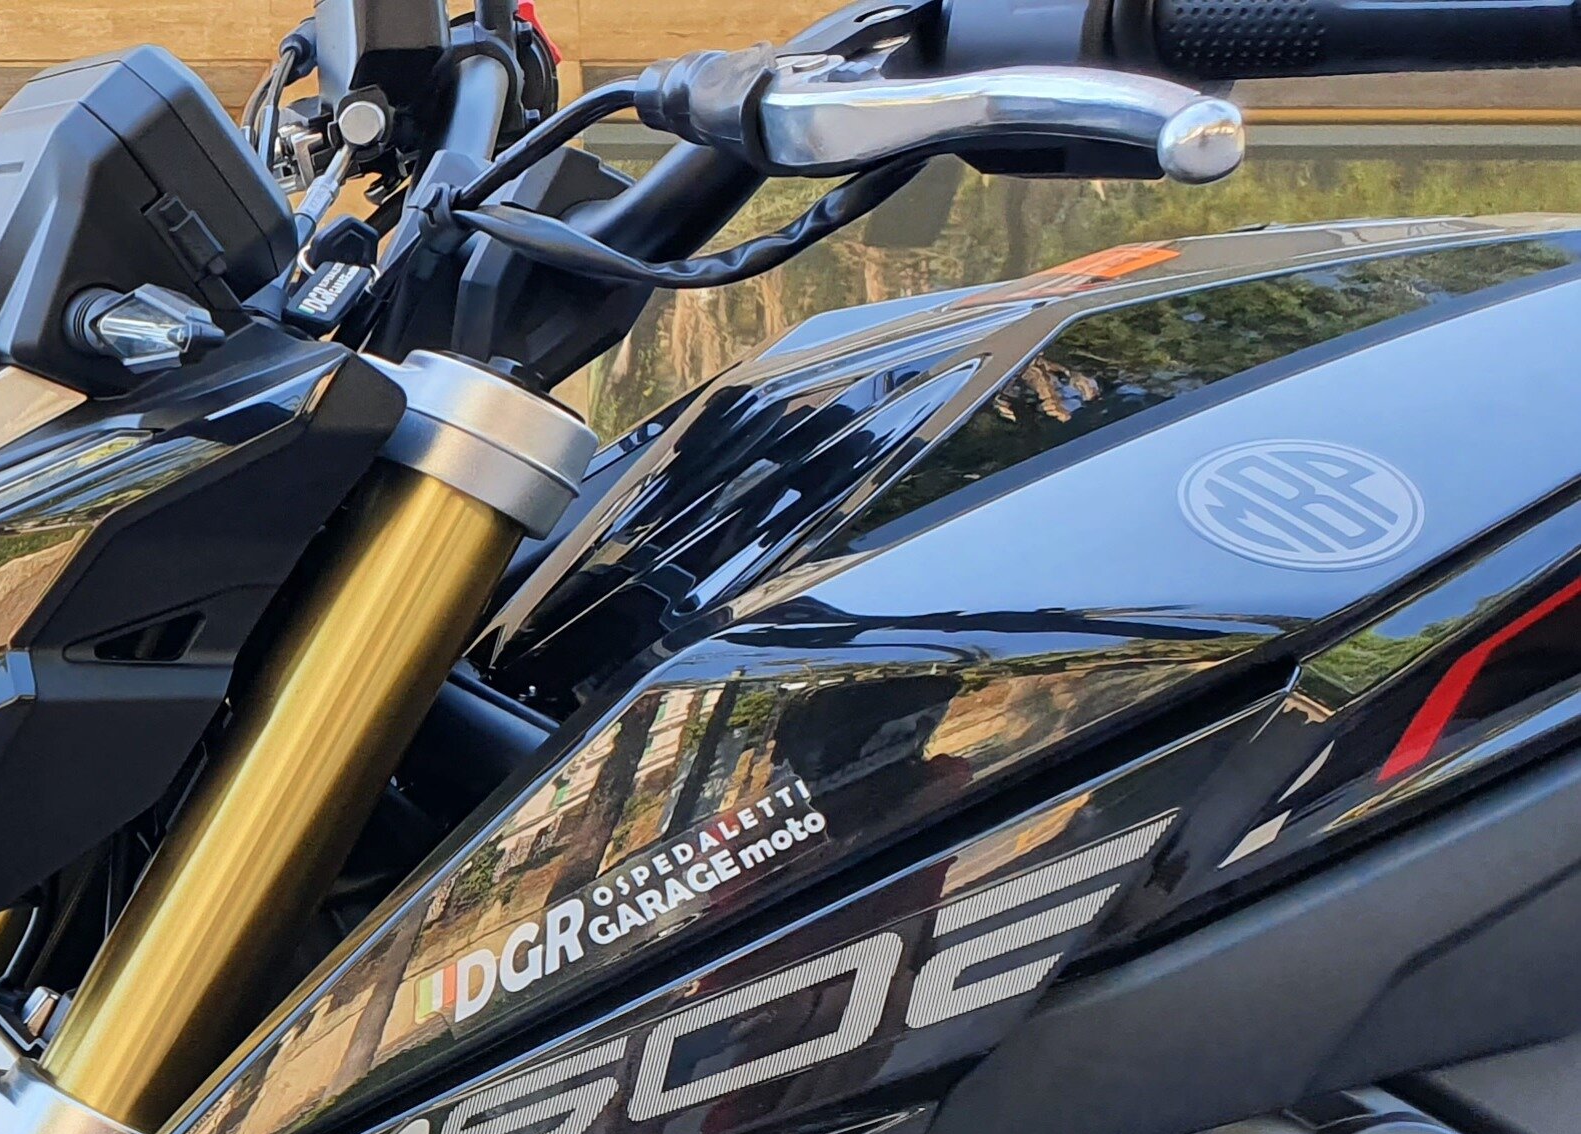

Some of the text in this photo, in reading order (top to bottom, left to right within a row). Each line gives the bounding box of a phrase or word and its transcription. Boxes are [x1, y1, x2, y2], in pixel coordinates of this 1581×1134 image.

[588, 849, 740, 945] GARAGE
[592, 779, 811, 907] OSPEDALETTI
[454, 898, 585, 1023] DGR
